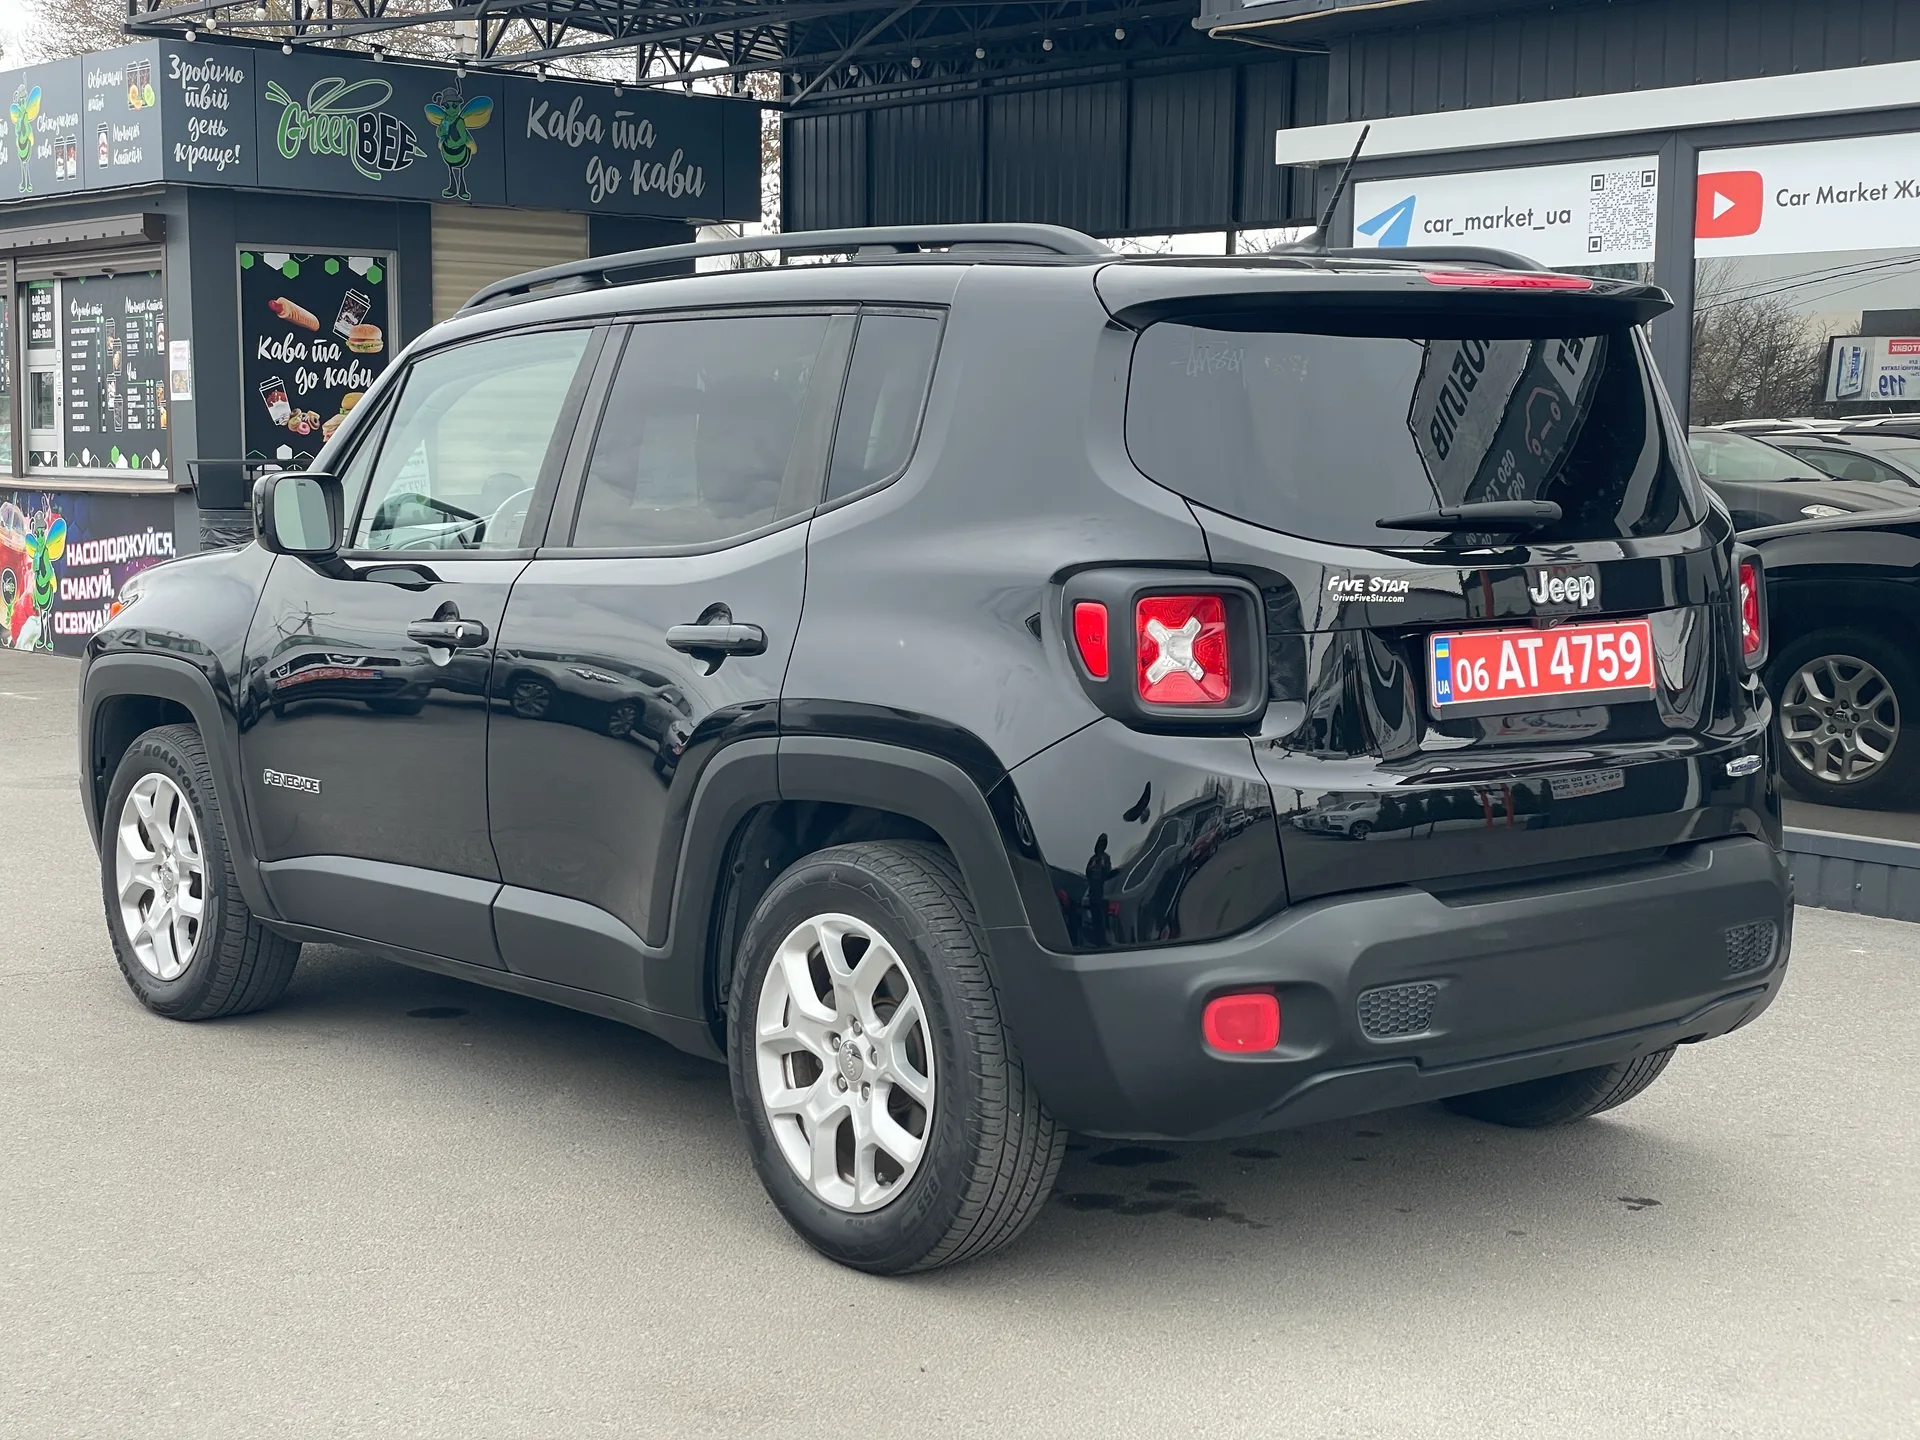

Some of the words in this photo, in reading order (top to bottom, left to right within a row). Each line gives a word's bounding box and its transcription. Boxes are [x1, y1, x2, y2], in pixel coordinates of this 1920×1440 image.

[168, 54, 245, 88] Зробимо
[185, 84, 230, 111] твій
[188, 117, 228, 141] день
[526, 96, 606, 148] Кава
[612, 110, 656, 151] та
[173, 142, 241, 172] краще!
[586, 155, 622, 204] до
[629, 148, 706, 199] кави
[1776, 188, 1810, 207] Car
[1816, 182, 1888, 205] Market
[1423, 205, 1571, 236] car_market_ua
[258, 332, 308, 363] Кава
[312, 339, 342, 362] та
[295, 366, 319, 395] до
[324, 359, 373, 389] кави
[66, 526, 176, 566] НАСОЛОДЖУЙСЯ,
[60, 568, 114, 601] СМАКУЙ,
[1327, 575, 1365, 592] FIVE
[1368, 577, 1410, 593] STAR
[1332, 594, 1405, 603] DriveFiveStar.com
[1529, 571, 1596, 607] Jeep
[1456, 657, 1490, 693] 06
[1497, 638, 1544, 690] AT
[1550, 631, 1642, 685] 4759
[1438, 680, 1451, 695] UA
[263, 768, 321, 794] RENEGADE
